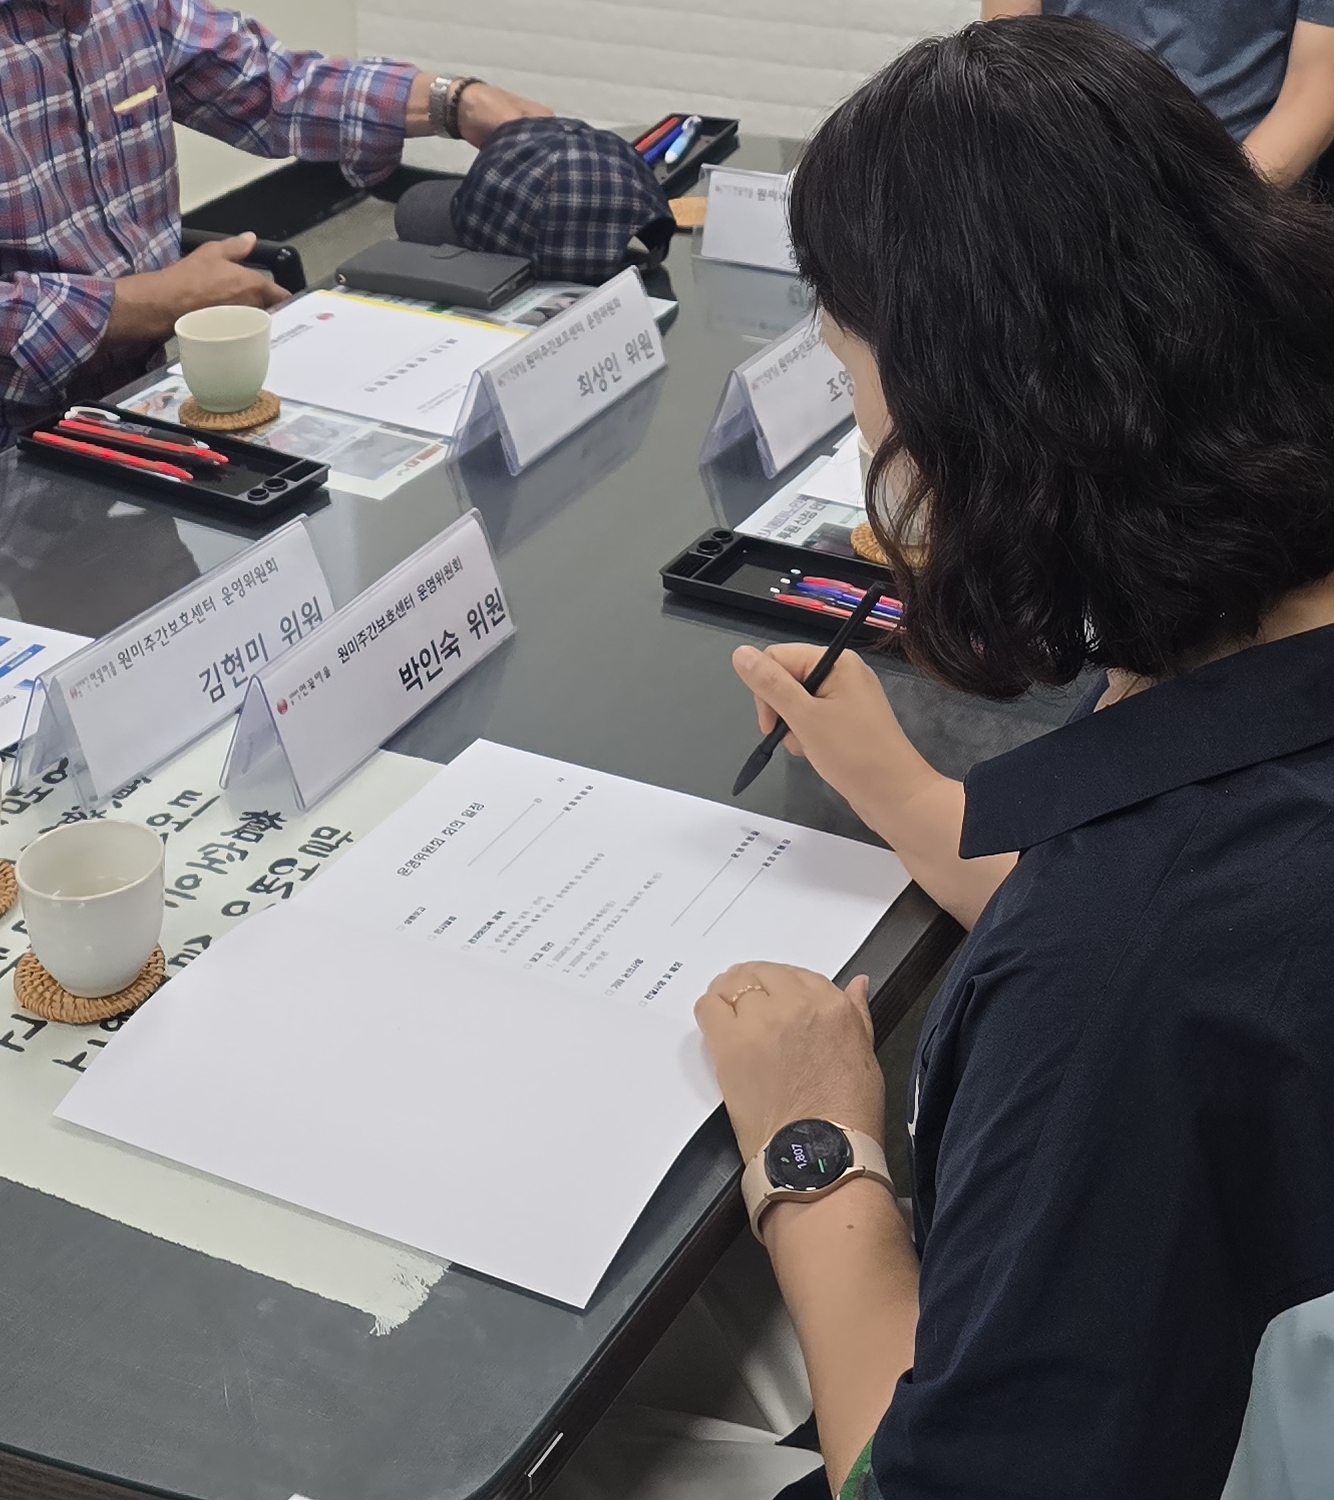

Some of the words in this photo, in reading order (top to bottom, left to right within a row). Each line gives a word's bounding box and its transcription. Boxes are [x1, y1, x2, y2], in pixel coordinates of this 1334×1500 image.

[577, 352, 622, 396] 최상인
[625, 329, 655, 364] 위원
[118, 597, 216, 670] 원미주간보호센터
[221, 558, 279, 605] 운영위원회
[199, 632, 269, 703] 김현미
[279, 596, 323, 643] 위원
[336, 590, 416, 664] 원미주간보호센터
[416, 555, 463, 602] 운영위원회
[398, 629, 461, 692] 박인숙
[466, 587, 506, 641] 위원
[396, 836, 446, 877] 운영위원회
